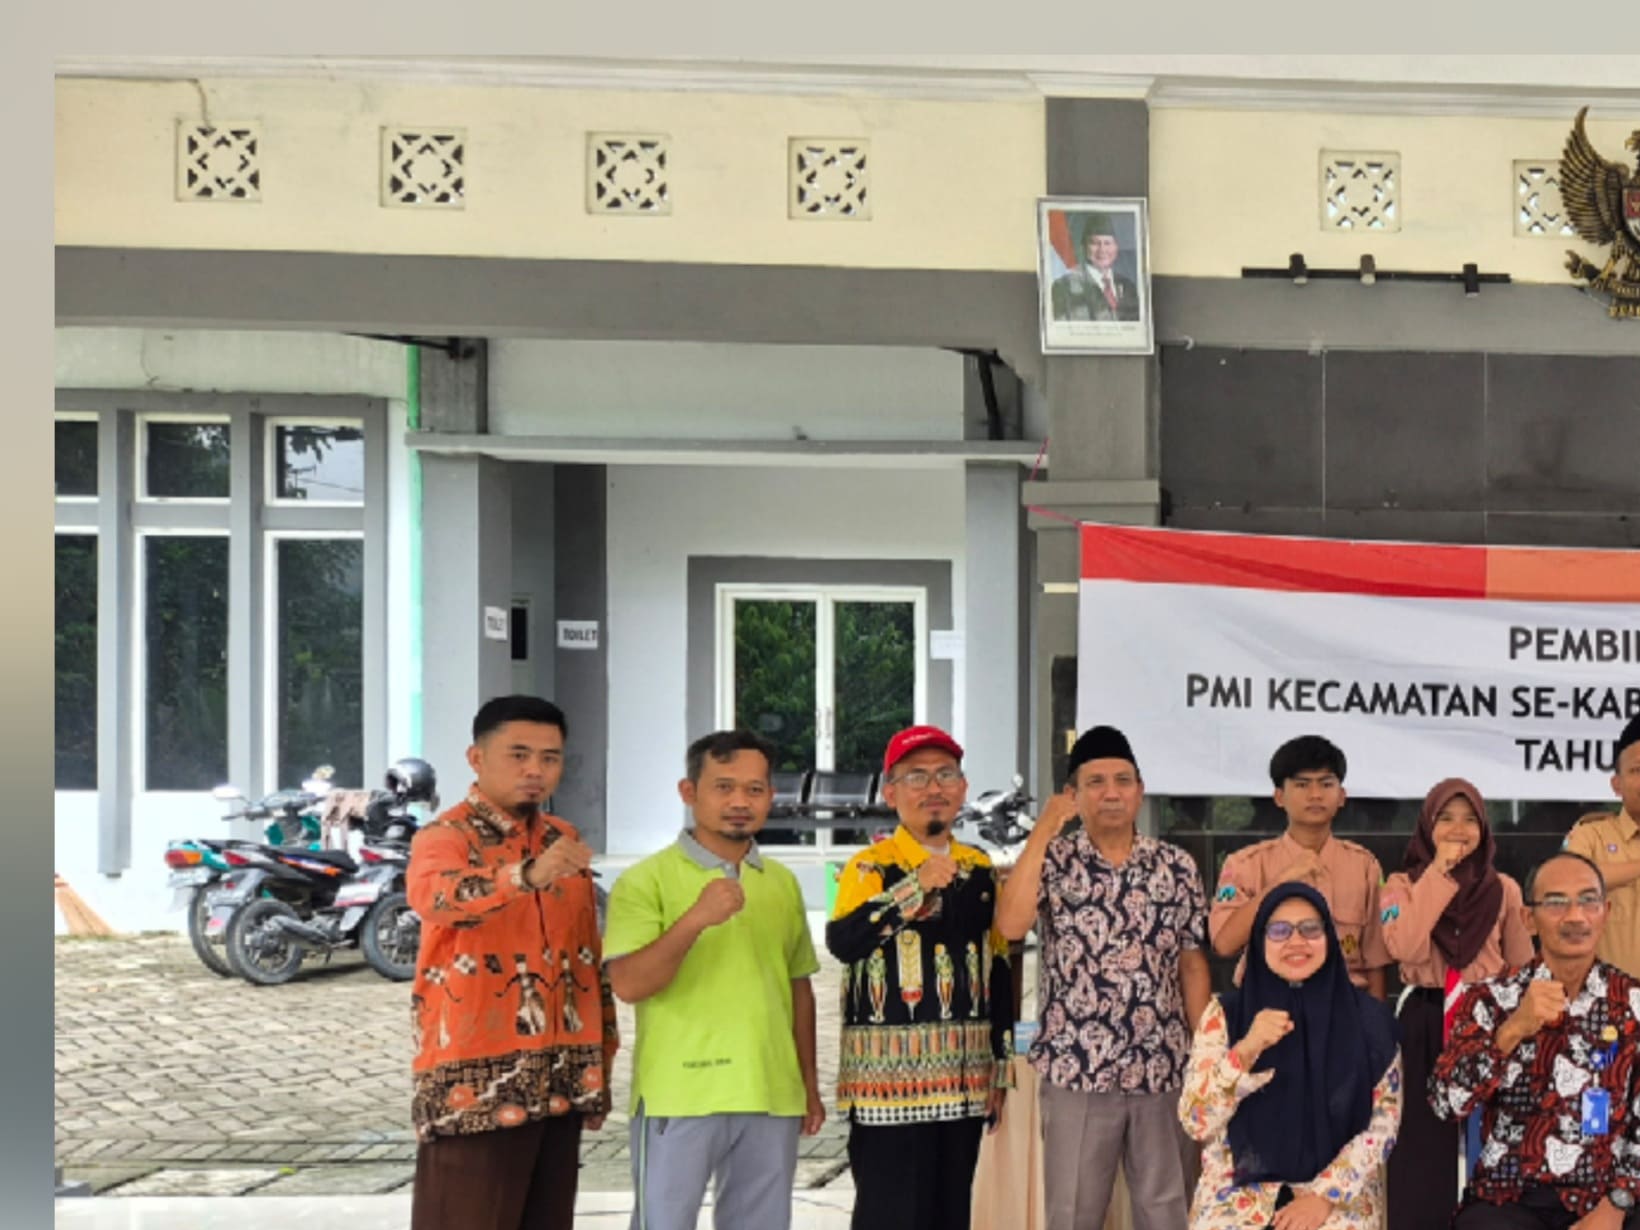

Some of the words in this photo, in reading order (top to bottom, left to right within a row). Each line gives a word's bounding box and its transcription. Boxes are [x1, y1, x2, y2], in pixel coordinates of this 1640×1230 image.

[1186, 673, 1252, 709] PMI
[1268, 678, 1498, 716] KECAMATAN
[1515, 739, 1620, 771] TAHU
